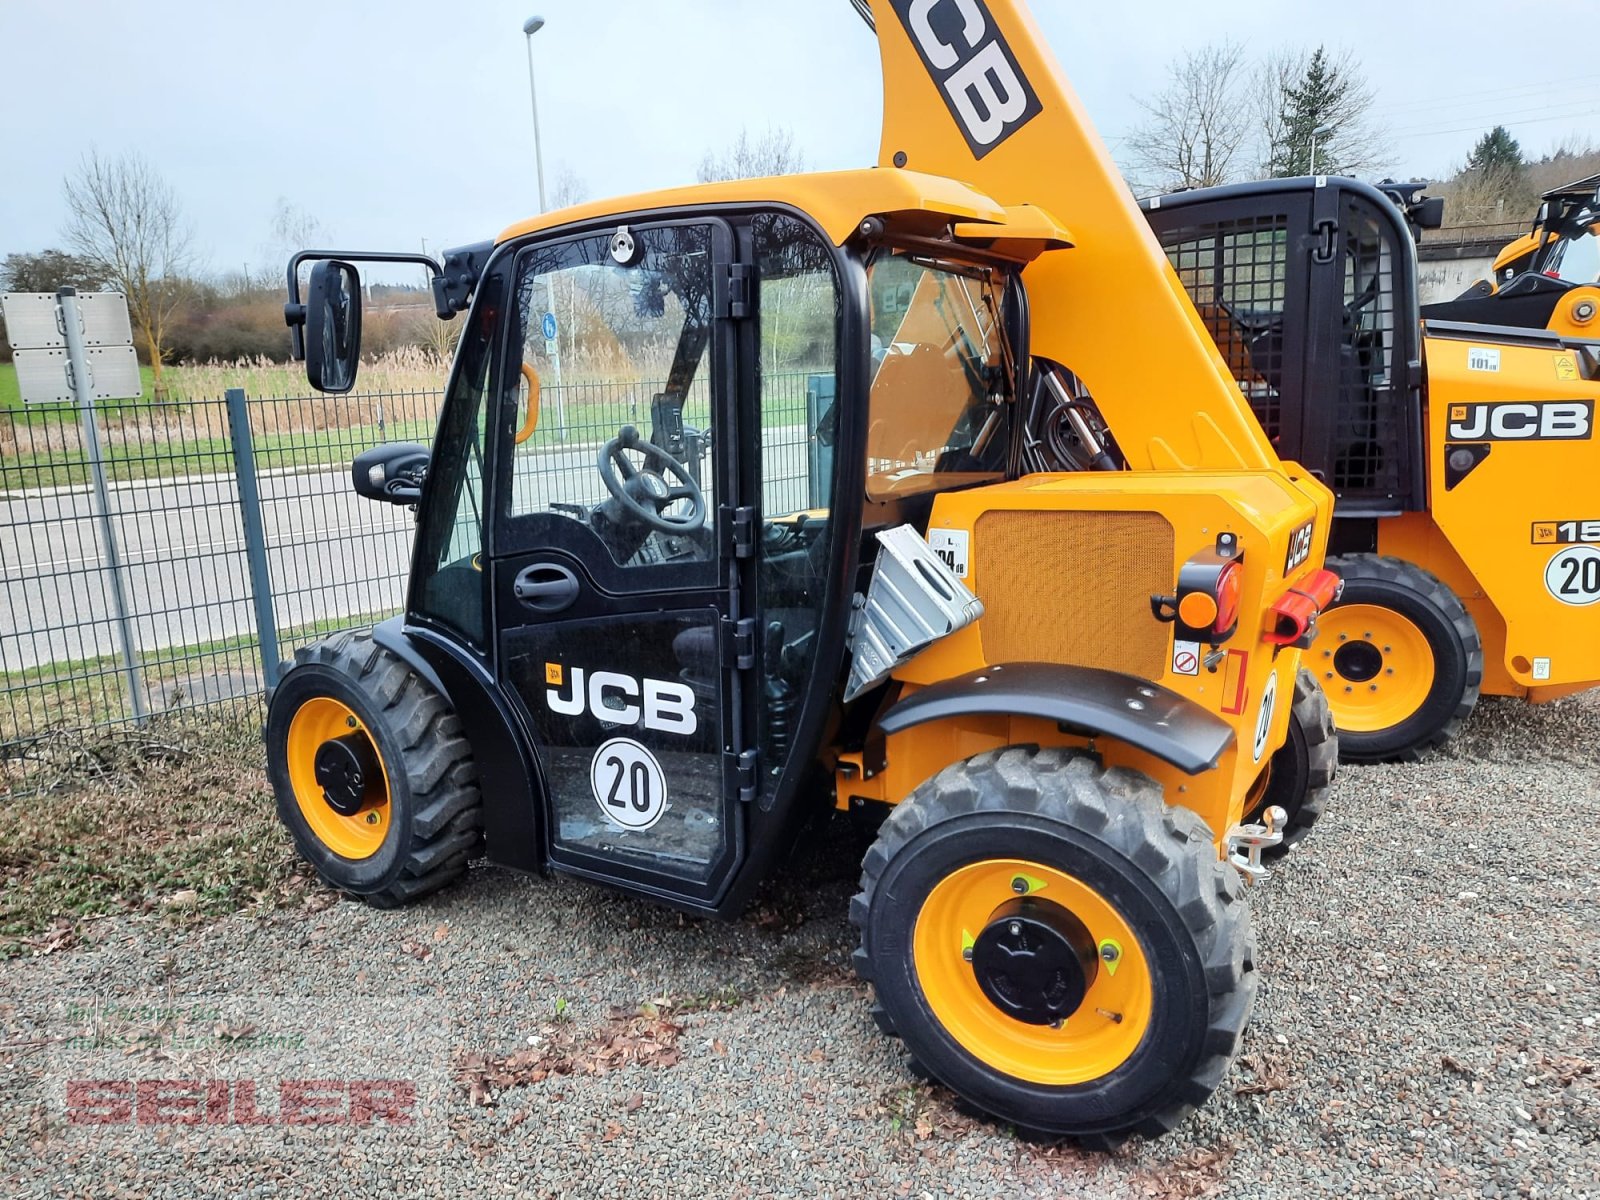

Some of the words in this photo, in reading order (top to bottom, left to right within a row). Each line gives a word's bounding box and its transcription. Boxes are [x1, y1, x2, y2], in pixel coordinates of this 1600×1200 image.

[1471, 358, 1489, 370] 101
[1450, 403, 1589, 439] JCB
[934, 549, 955, 573] 04
[1560, 557, 1600, 594] 20
[546, 667, 697, 735] JCB
[1256, 687, 1274, 748] 20
[606, 755, 650, 812] 20
